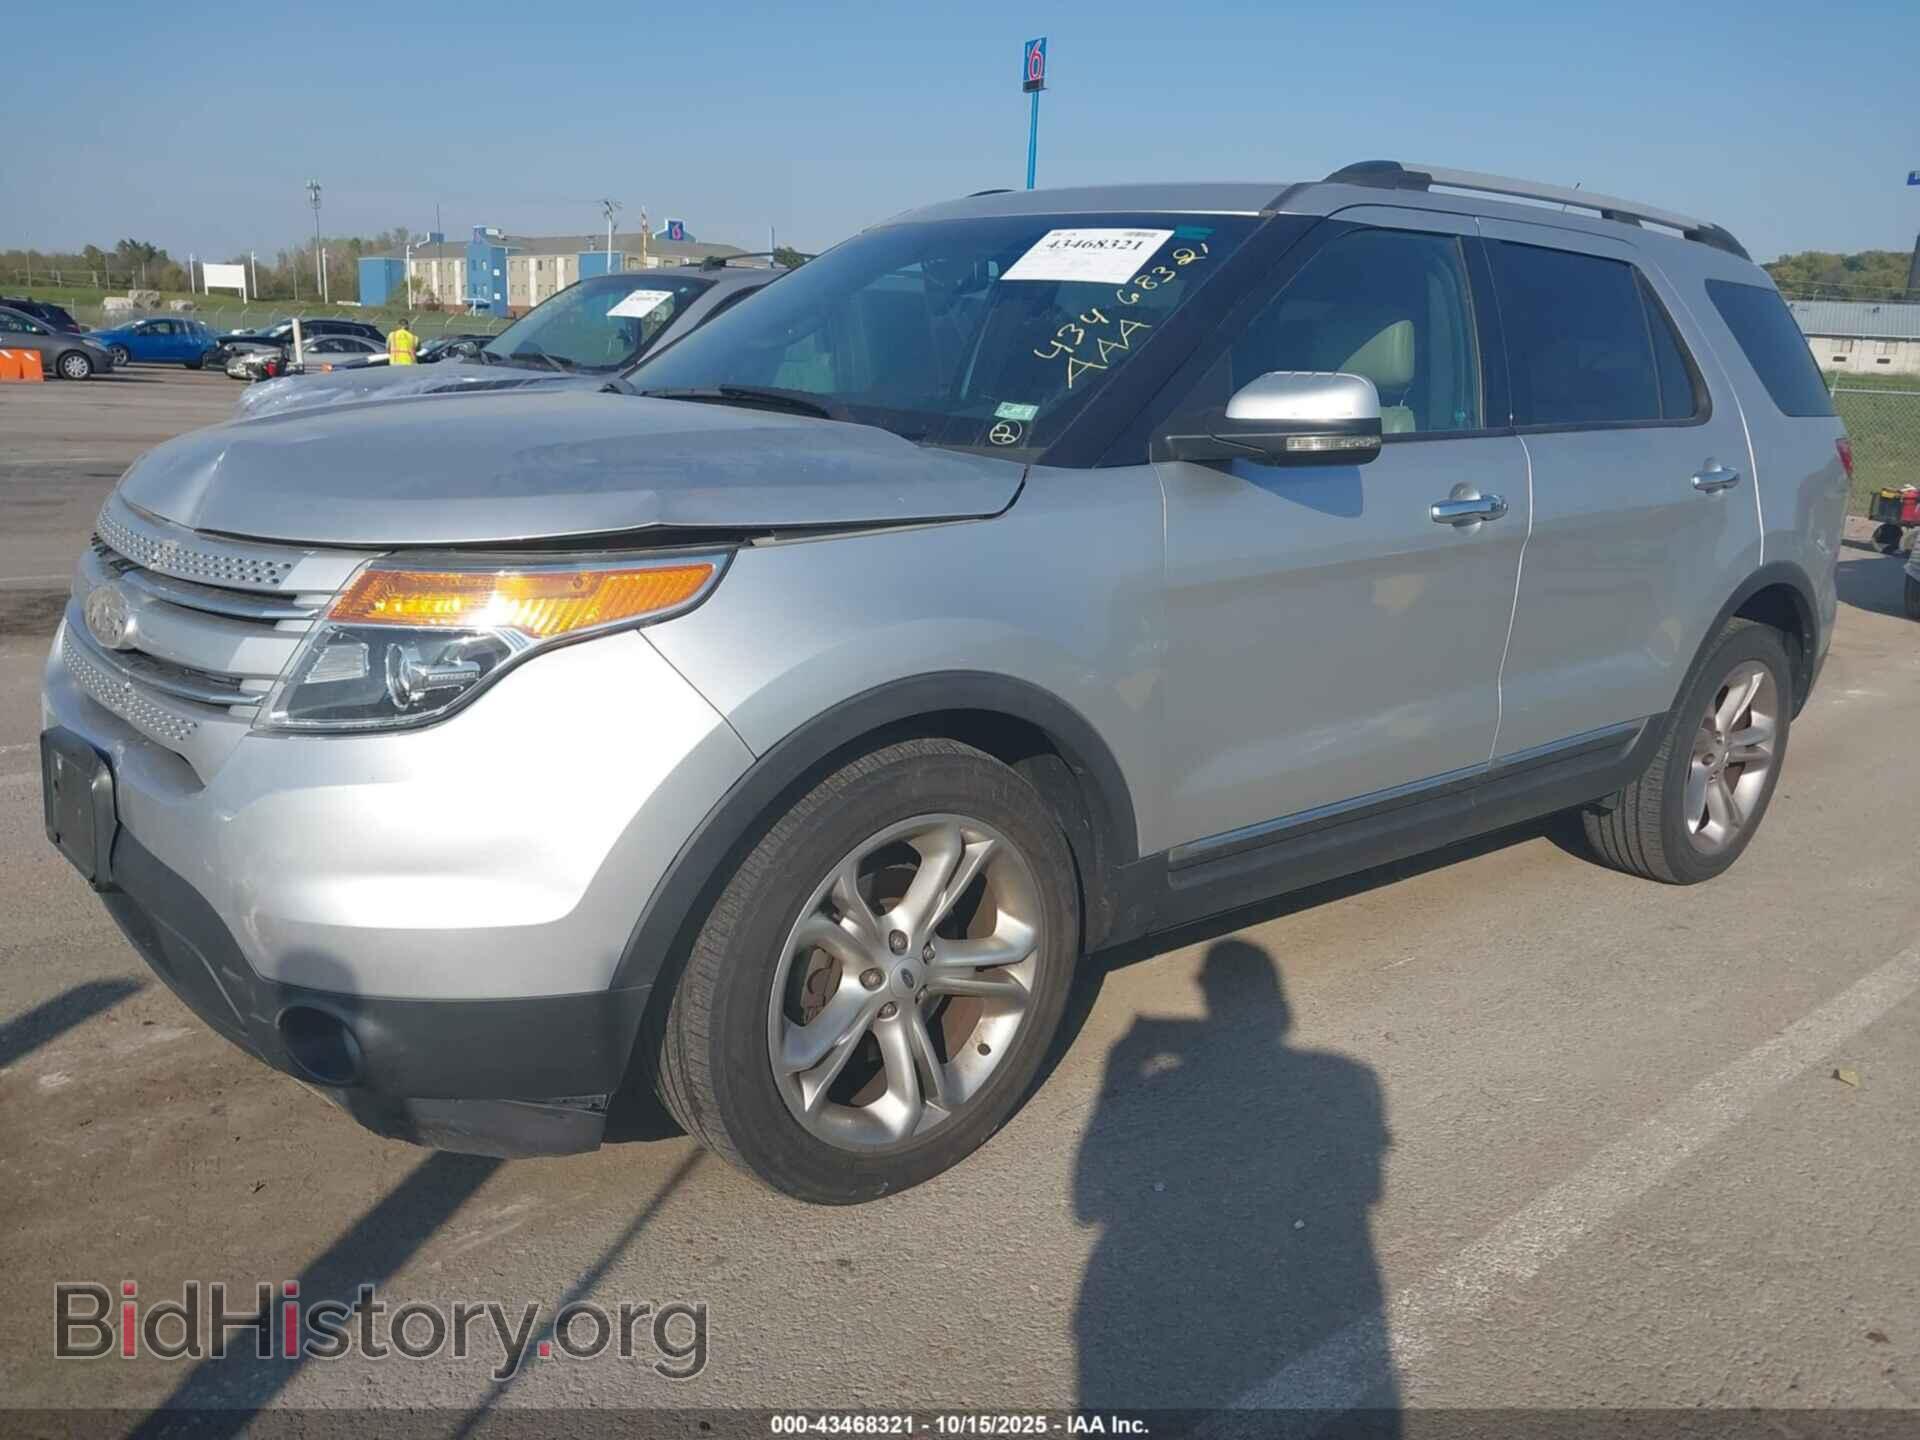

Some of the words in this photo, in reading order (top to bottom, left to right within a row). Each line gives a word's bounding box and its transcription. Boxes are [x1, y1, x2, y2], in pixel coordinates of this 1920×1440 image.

[1028, 39, 1044, 81] 6
[1046, 239, 1144, 251] 43468321
[1068, 318, 1153, 389] AAA
